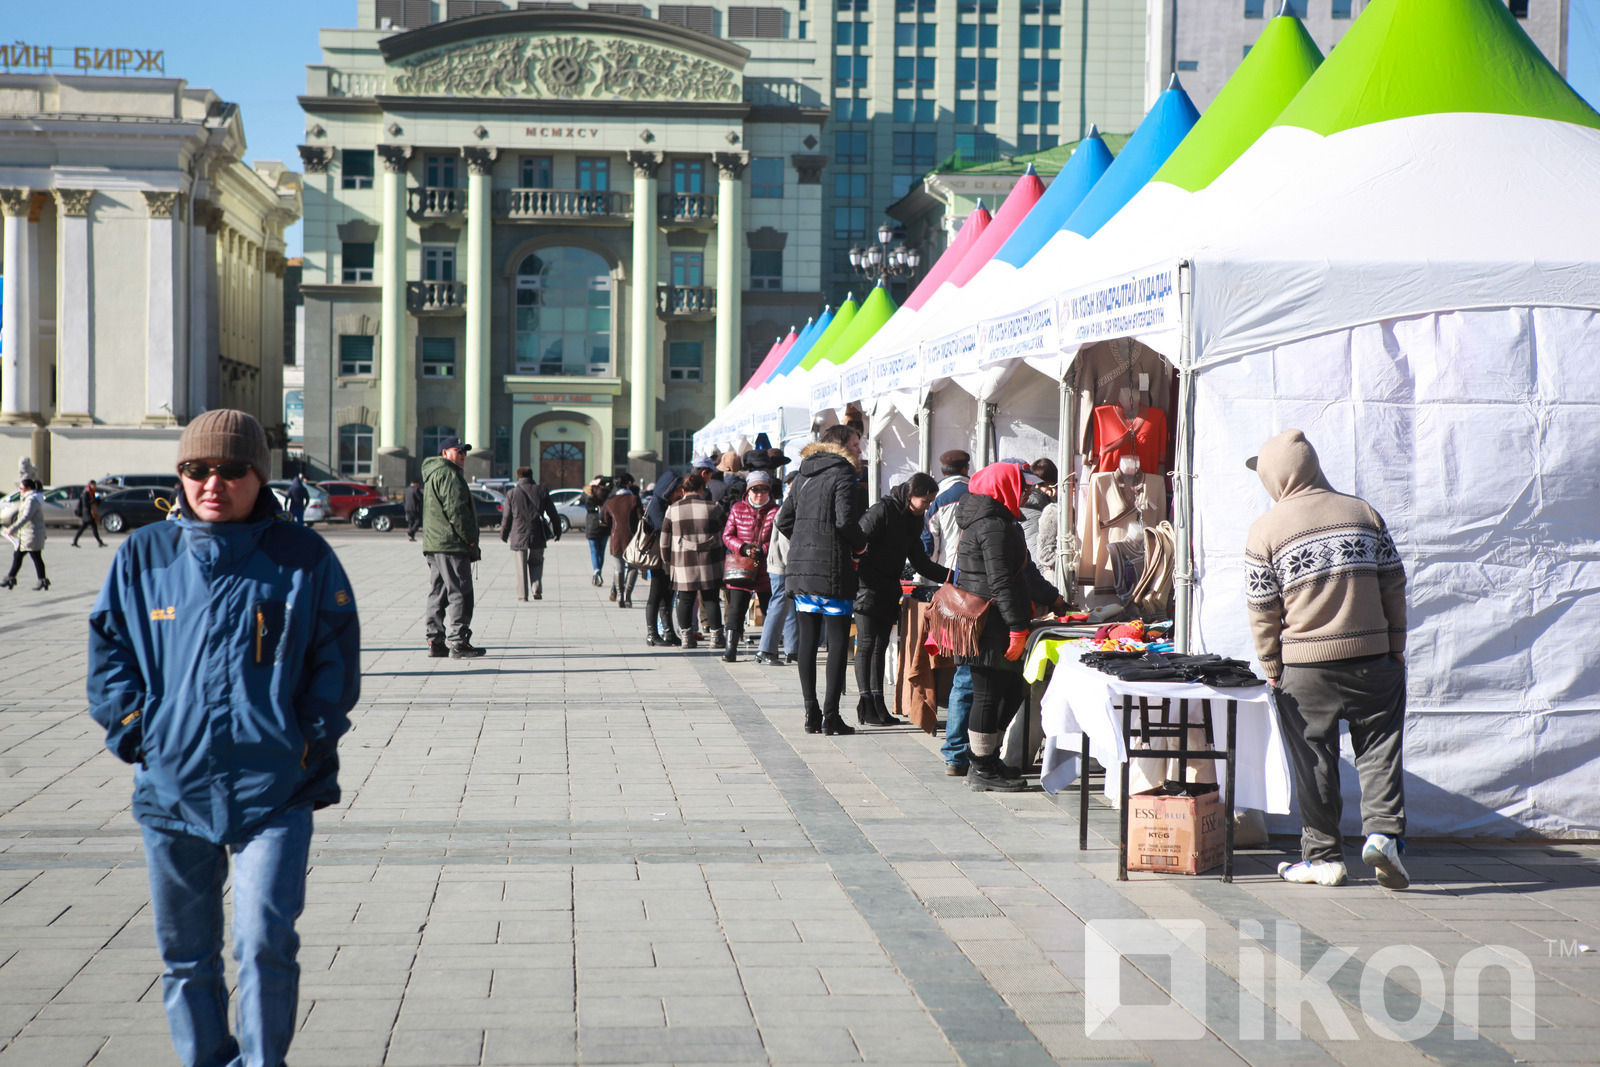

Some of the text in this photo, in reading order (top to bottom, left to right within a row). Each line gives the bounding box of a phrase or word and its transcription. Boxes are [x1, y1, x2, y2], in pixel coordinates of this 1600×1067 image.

[74, 47, 164, 72] БИРЖ
[525, 127, 599, 138] MCMXCV
[1138, 271, 1172, 307] ХУДАЛДАА
[1135, 808, 1187, 820] ESSE BLUE
